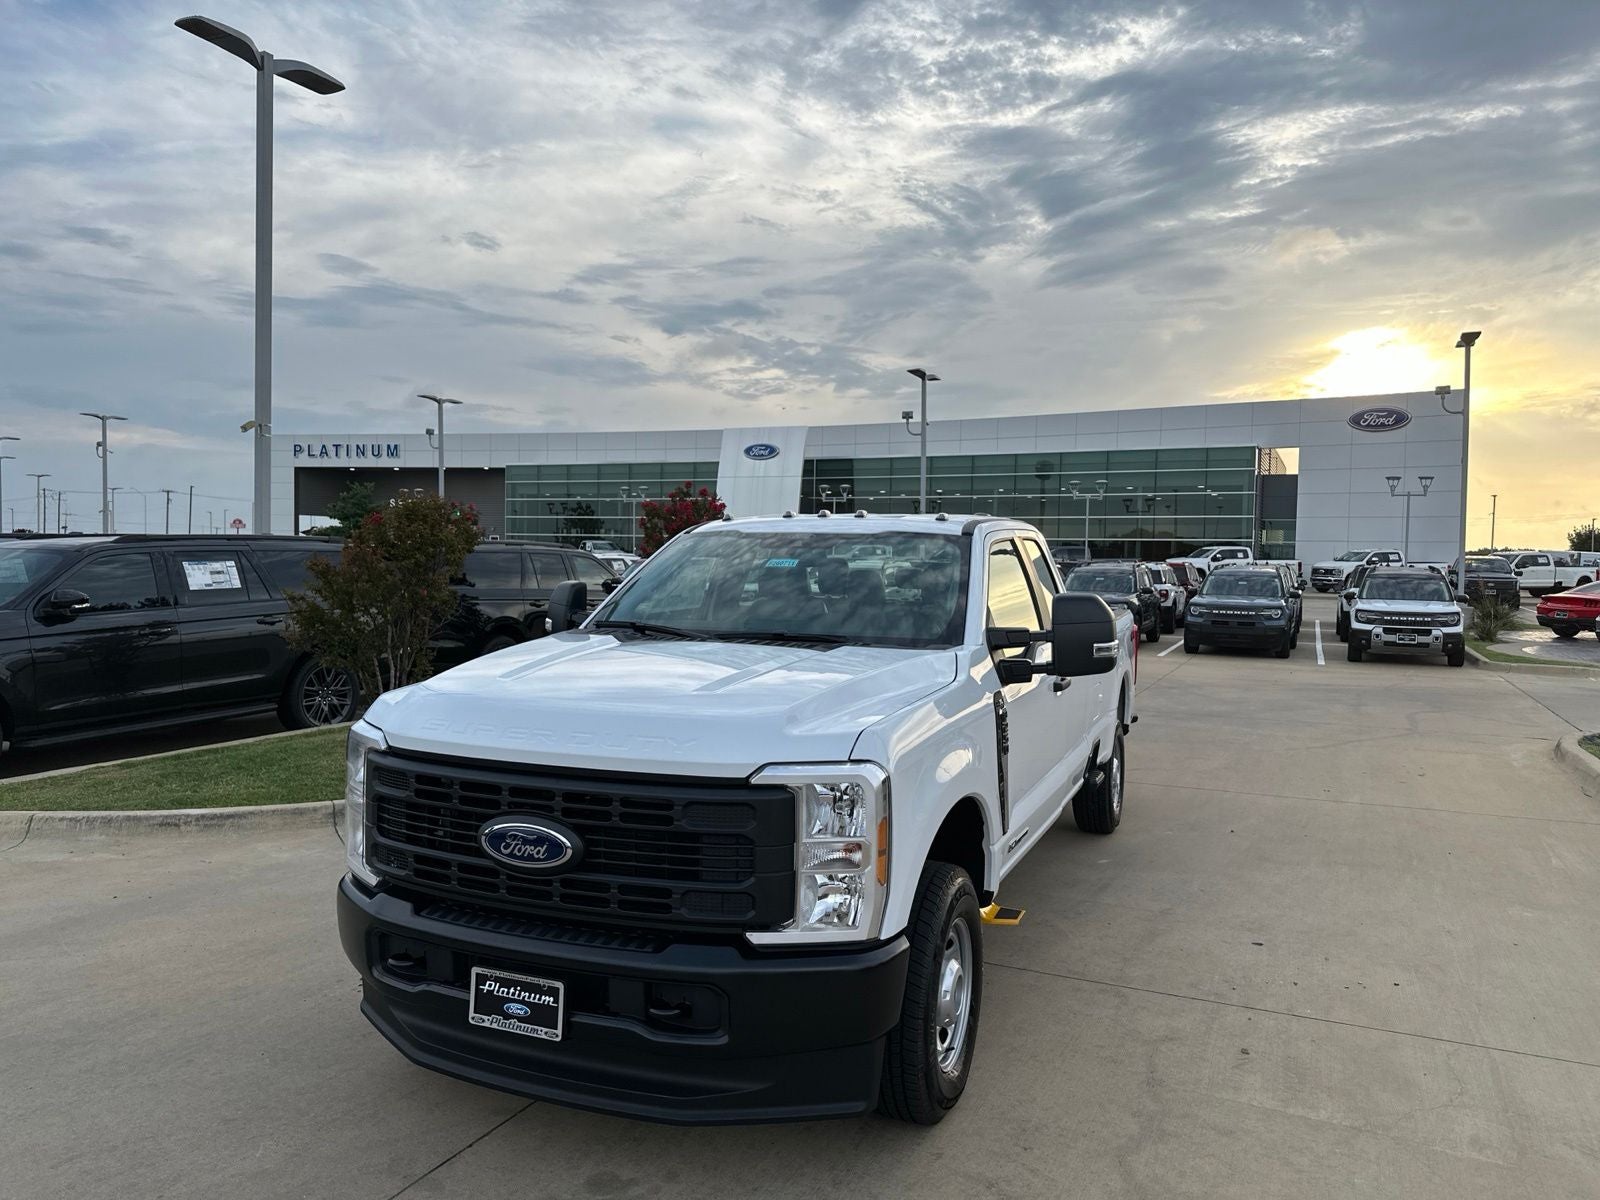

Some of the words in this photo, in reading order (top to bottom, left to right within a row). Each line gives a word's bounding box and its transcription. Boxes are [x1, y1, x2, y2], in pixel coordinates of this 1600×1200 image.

[1360, 411, 1397, 426] Ford
[293, 443, 399, 458] PLATINUM
[750, 446, 771, 456] Ford
[500, 831, 548, 859] Ford
[479, 980, 559, 1007] Platinum
[508, 1004, 526, 1015] Ford
[489, 1016, 541, 1036] Platinum
